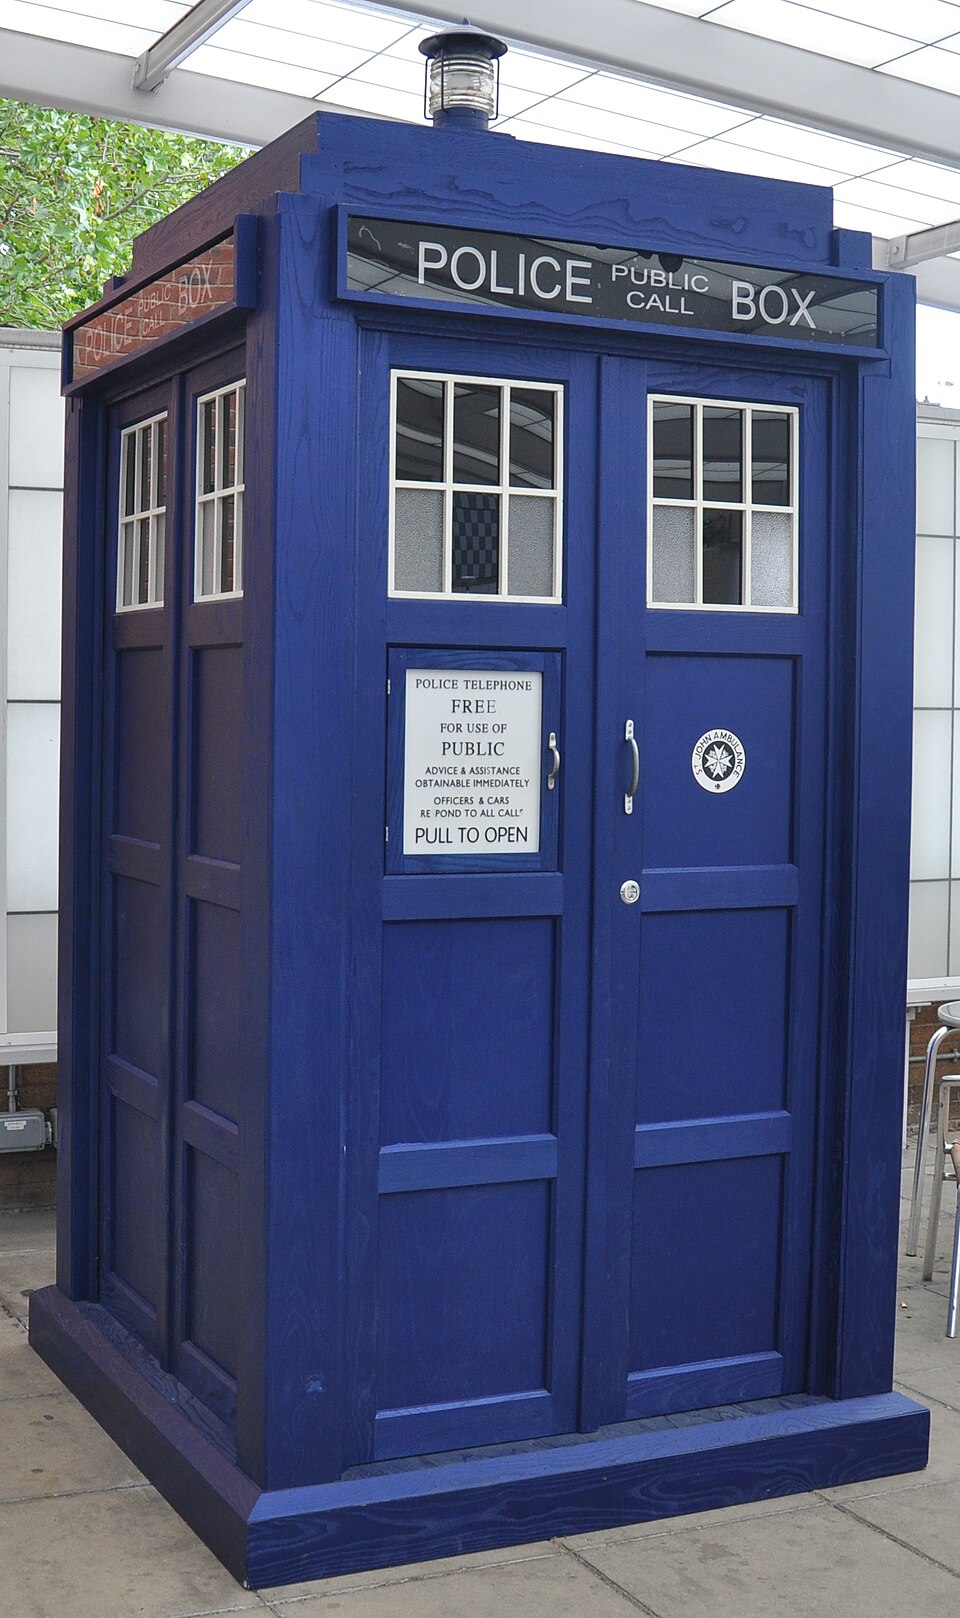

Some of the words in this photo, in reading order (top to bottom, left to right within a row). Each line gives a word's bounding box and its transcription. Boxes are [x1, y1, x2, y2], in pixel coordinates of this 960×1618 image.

[417, 241, 593, 304] POLICE
[611, 264, 709, 293] PUBLIC
[178, 260, 213, 315] BOX
[137, 285, 171, 317] PUBLIC
[626, 291, 695, 315] CALL
[731, 281, 817, 329] BOX
[142, 311, 166, 334] CALL
[85, 307, 134, 366] POLICE
[415, 679, 458, 689] POLICE
[463, 680, 532, 691] TELEPHONE
[451, 700, 496, 713] FREE
[440, 723, 462, 733] FOR
[467, 724, 488, 733] USE
[492, 724, 507, 733] OF
[442, 742, 504, 756] PUBLIC
[695, 734, 712, 760] JOHN
[713, 732, 743, 778] AMBULANCE
[425, 767, 458, 775] ADVICE
[434, 797, 474, 805] OFFICERS
[421, 809, 461, 817] REPOND
[415, 828, 452, 843] PULL
[458, 828, 479, 843] TO
[485, 827, 528, 843] OPEN
